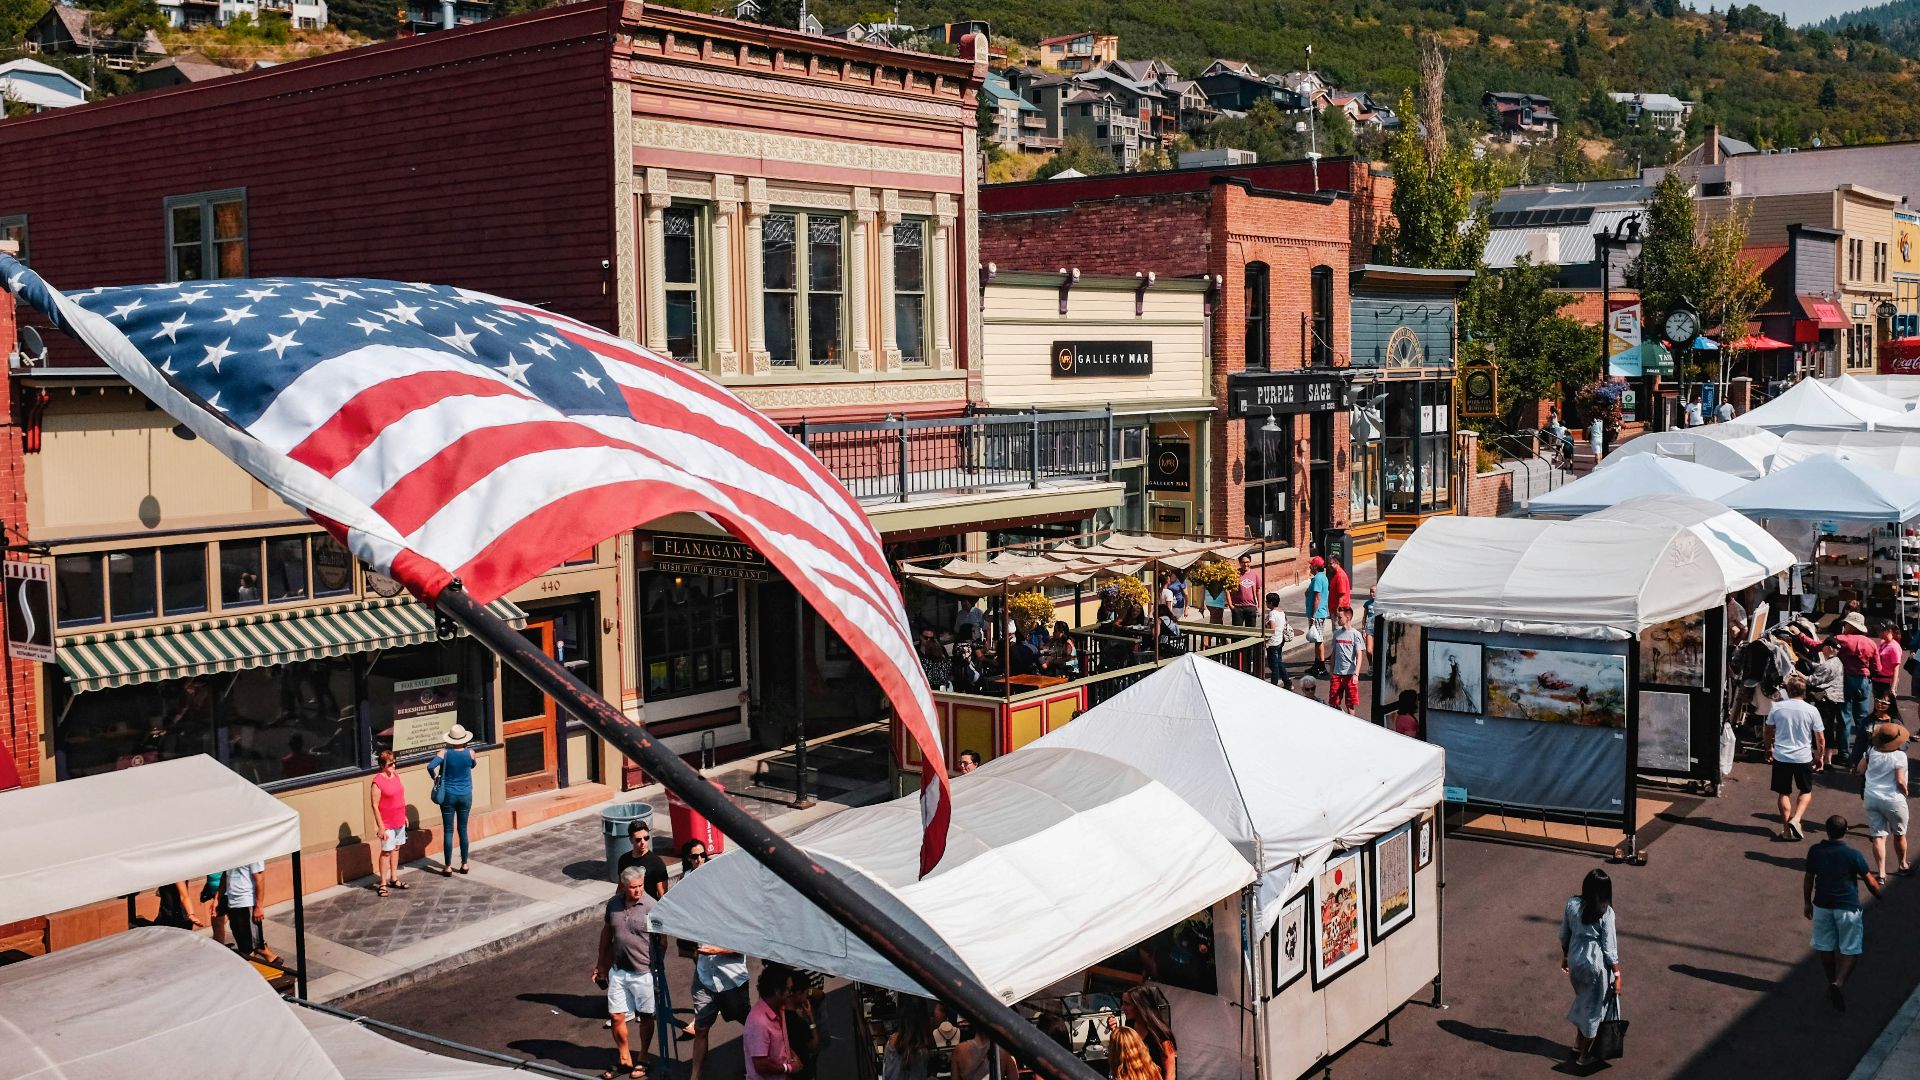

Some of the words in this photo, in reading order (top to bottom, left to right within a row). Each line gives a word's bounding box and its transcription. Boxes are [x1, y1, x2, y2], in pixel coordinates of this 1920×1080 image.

[1078, 354, 1124, 364] GALLERY
[1129, 353, 1149, 364] MAR
[1258, 385, 1294, 404] PURPLE
[1308, 383, 1331, 401] SAGE
[665, 540, 754, 561] FLANAGAN'S
[659, 562, 681, 572] IRISH
[683, 564, 698, 573] PUB
[708, 567, 761, 579] RESTAURANT
[541, 580, 561, 592] 440
[401, 682, 413, 690] FOR
[414, 680, 429, 688] SALE
[433, 676, 452, 686] LEASE
[397, 705, 427, 714] BERKSHIRE
[428, 701, 455, 709] HATHAWAY
